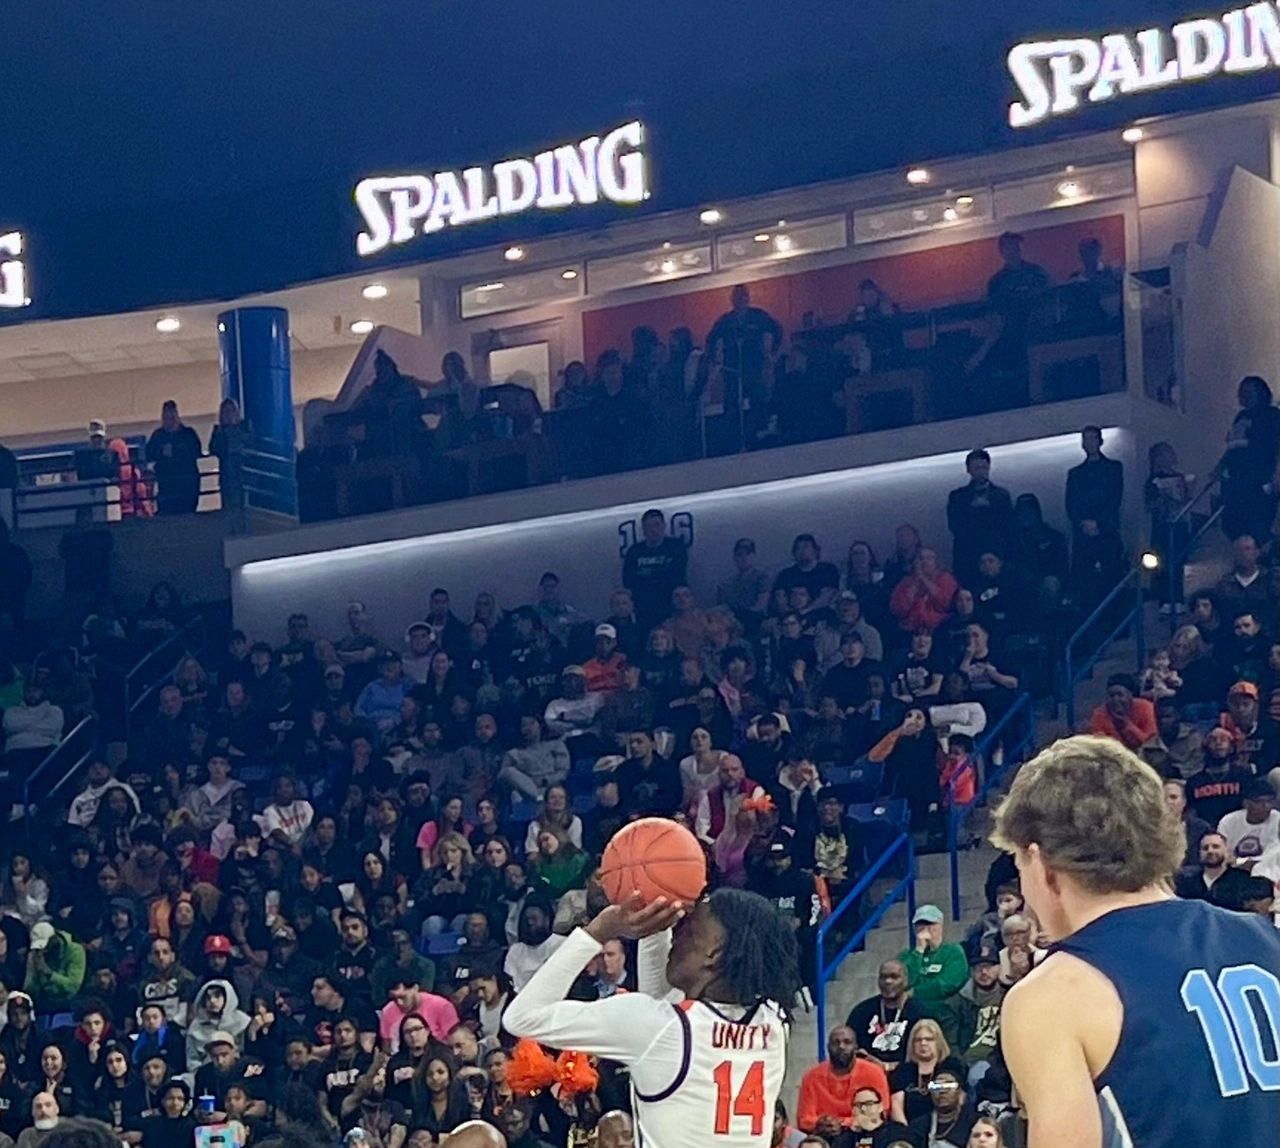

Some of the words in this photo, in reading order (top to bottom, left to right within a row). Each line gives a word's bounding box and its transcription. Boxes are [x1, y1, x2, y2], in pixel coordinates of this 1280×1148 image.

[355, 121, 651, 256] SPALDING
[712, 1021, 770, 1050] UNITY
[1180, 963, 1280, 1098] 10
[713, 1060, 766, 1136] 14
